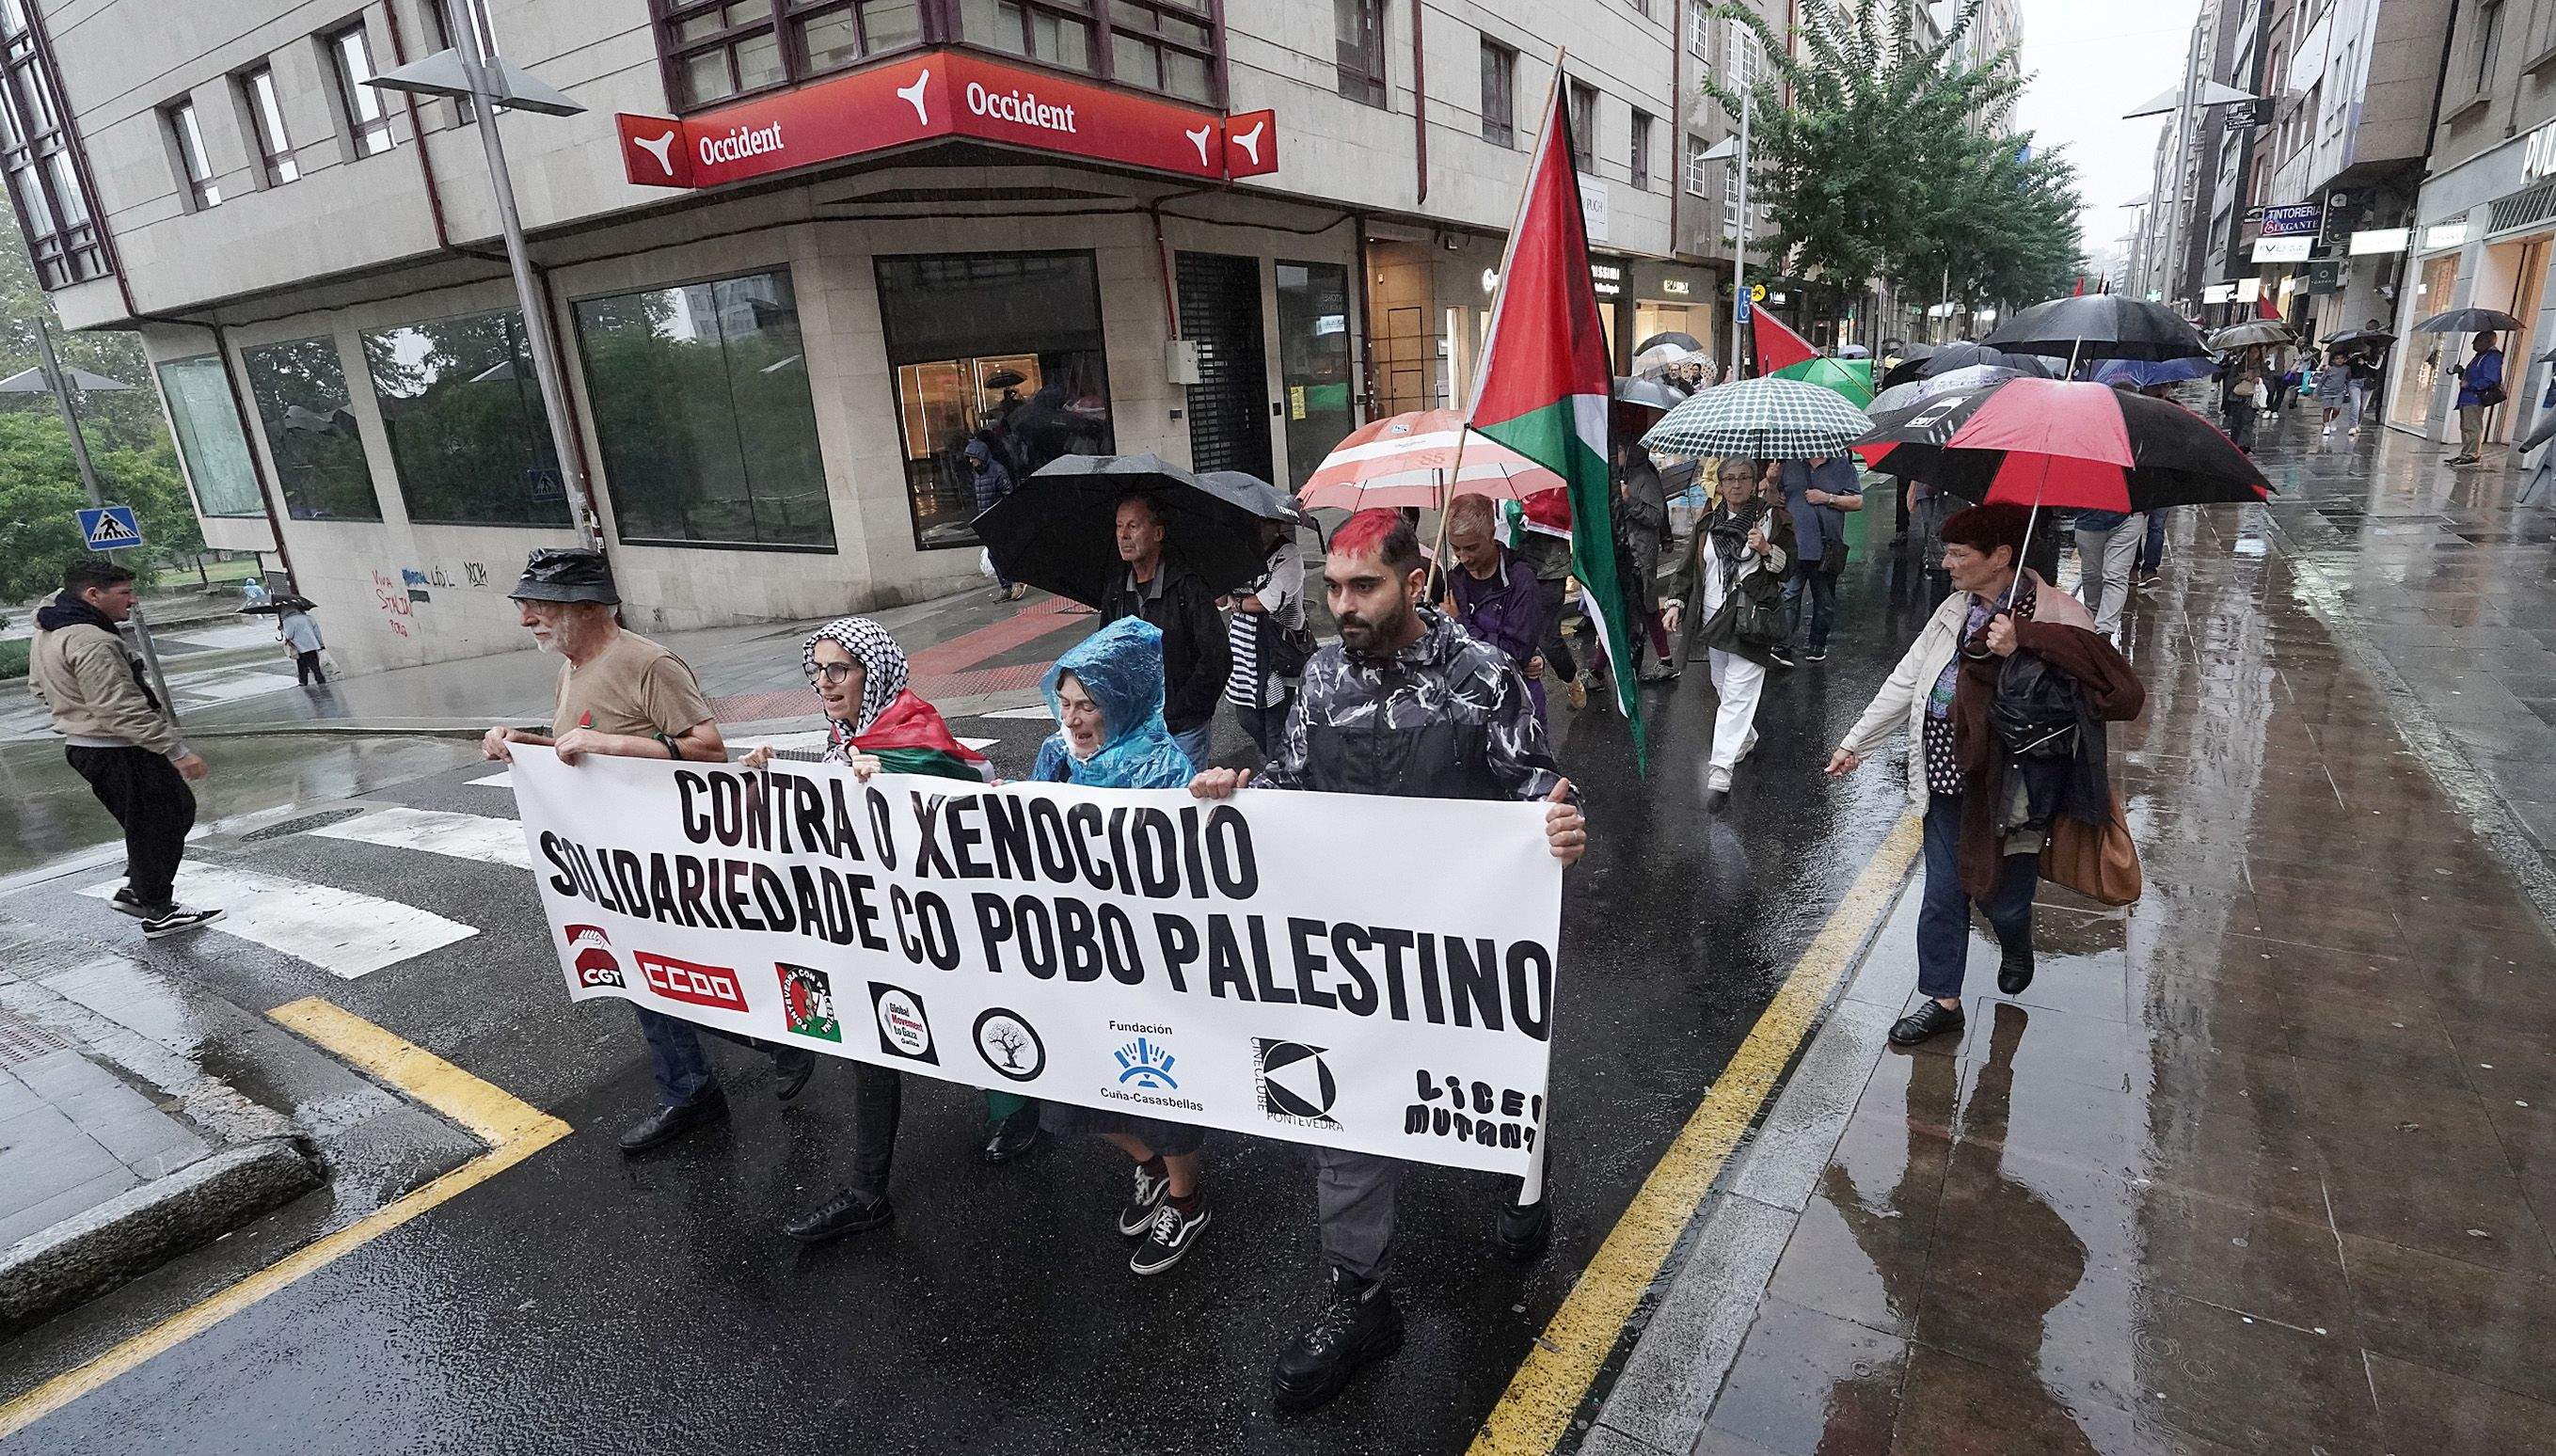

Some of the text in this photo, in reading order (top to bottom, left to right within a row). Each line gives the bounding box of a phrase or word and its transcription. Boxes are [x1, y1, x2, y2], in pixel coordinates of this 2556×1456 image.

[966, 82, 1077, 134] Occident
[699, 119, 785, 166] Occident
[674, 769, 1259, 900] CONTRA O XENOCIDIO
[540, 830, 1552, 1042] SOLIDARIEDADE CO POBO PALESTINO
[583, 968, 621, 986] CGT
[643, 961, 738, 1002] CCOO
[784, 971, 808, 1031] PONTEVEDRA
[798, 968, 816, 982] CON
[889, 1002, 910, 1017] Global
[891, 1014, 924, 1032] Movement
[894, 1025, 918, 1040] to Gaza
[1109, 1021, 1173, 1035] Fundación
[1250, 1037, 1268, 1111] CINECLUBE
[1100, 1087, 1204, 1112] Cuña-Casasbellas
[1266, 1112, 1344, 1132] PONTEVEDRA
